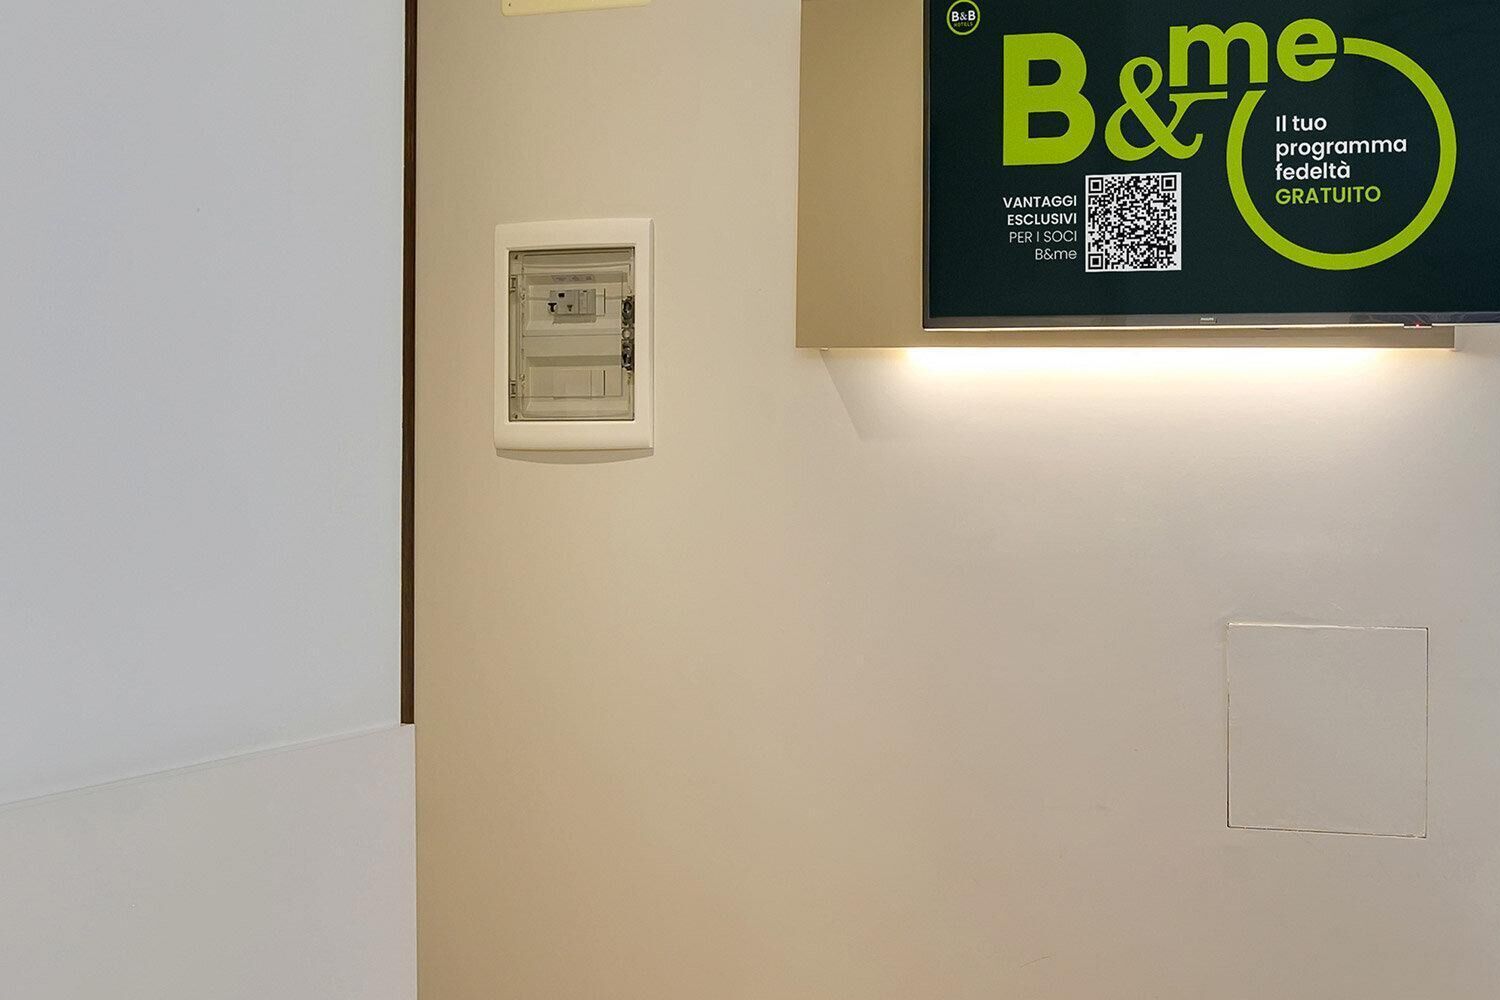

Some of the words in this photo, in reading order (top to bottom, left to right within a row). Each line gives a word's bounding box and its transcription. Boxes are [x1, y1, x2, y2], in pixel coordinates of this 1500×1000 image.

[951, 10, 976, 22] B&B
[1003, 18, 1338, 166] B&me
[1276, 115, 1287, 132] Il
[1292, 115, 1327, 131] tuo
[1276, 138, 1407, 161] programma
[1275, 160, 1350, 180] fedeltà
[1003, 195, 1077, 208] VANTAGGI
[1275, 185, 1381, 205] GRATUITO
[1007, 213, 1077, 226] ESCLUSIVI
[1009, 231, 1033, 243] PER
[1036, 231, 1040, 243] I
[1044, 230, 1077, 243] SOCI
[1035, 248, 1077, 261] B&me
